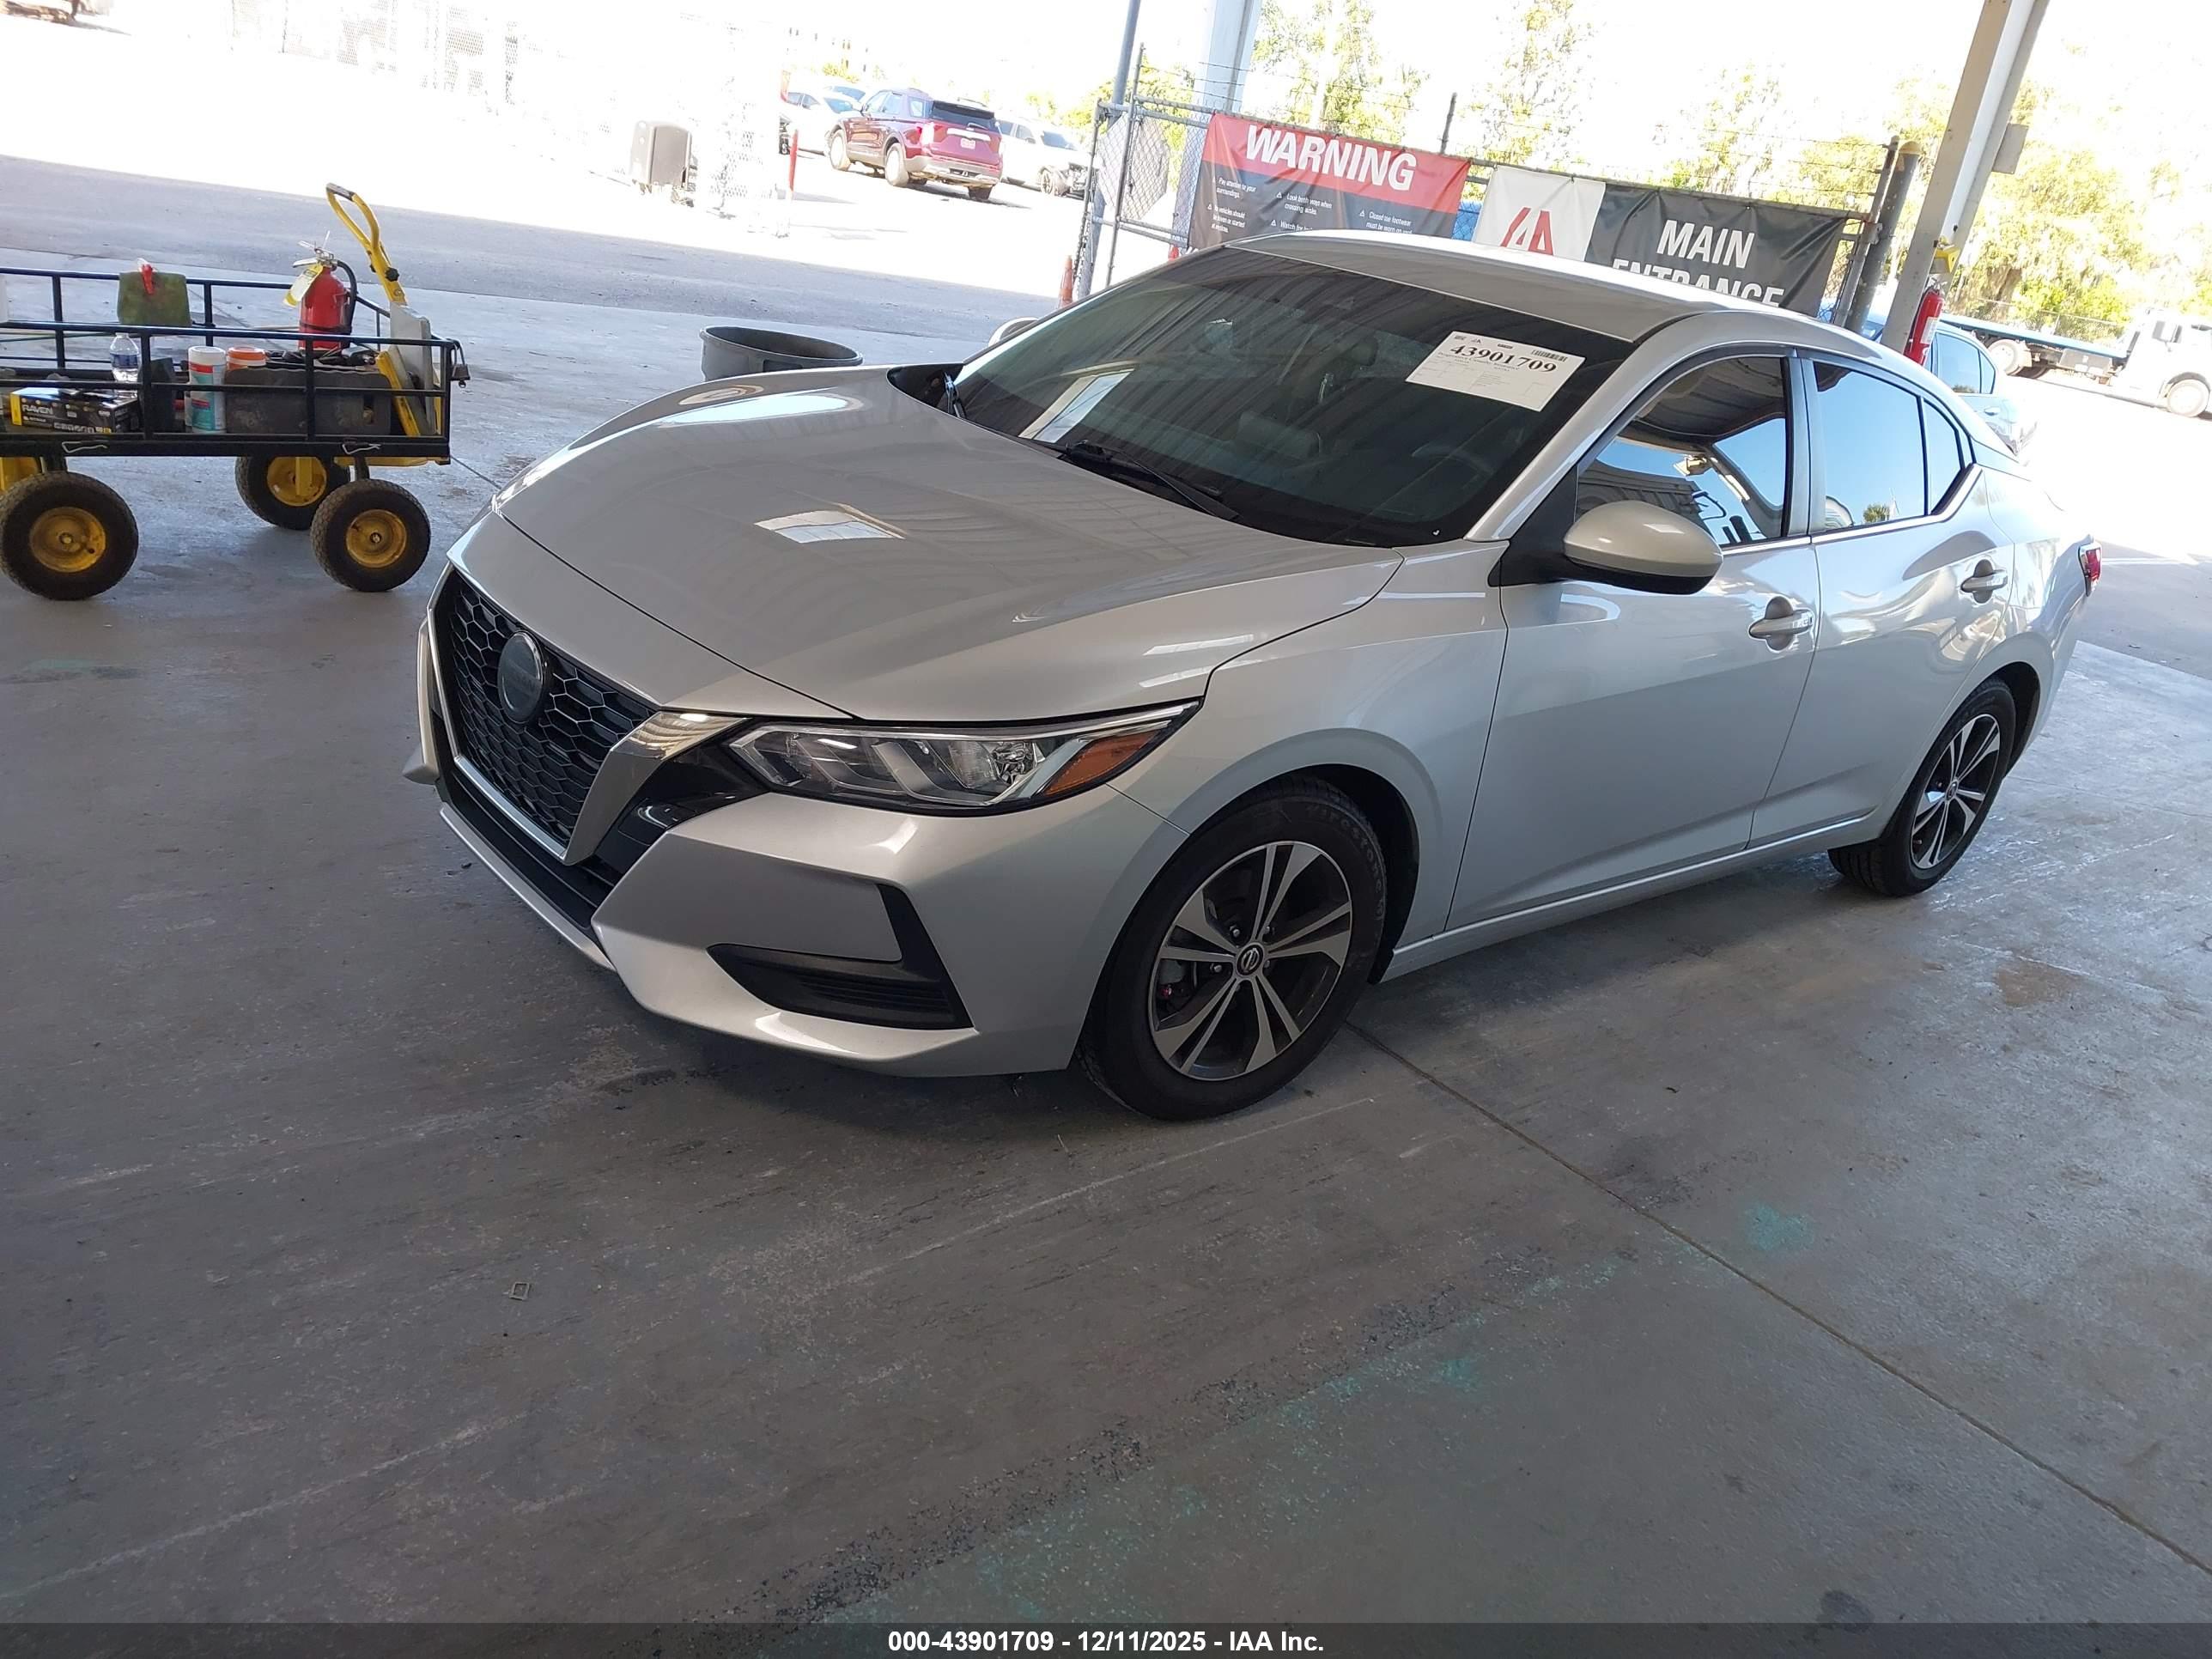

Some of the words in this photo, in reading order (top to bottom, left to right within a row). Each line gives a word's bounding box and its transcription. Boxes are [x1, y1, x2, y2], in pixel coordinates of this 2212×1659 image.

[1246, 125, 1417, 191] WARNING
[1392, 216, 1413, 227] footwear
[1656, 219, 1754, 269] MAIN
[1450, 344, 1557, 373] 43901709
[21, 404, 53, 415] RAVEN
